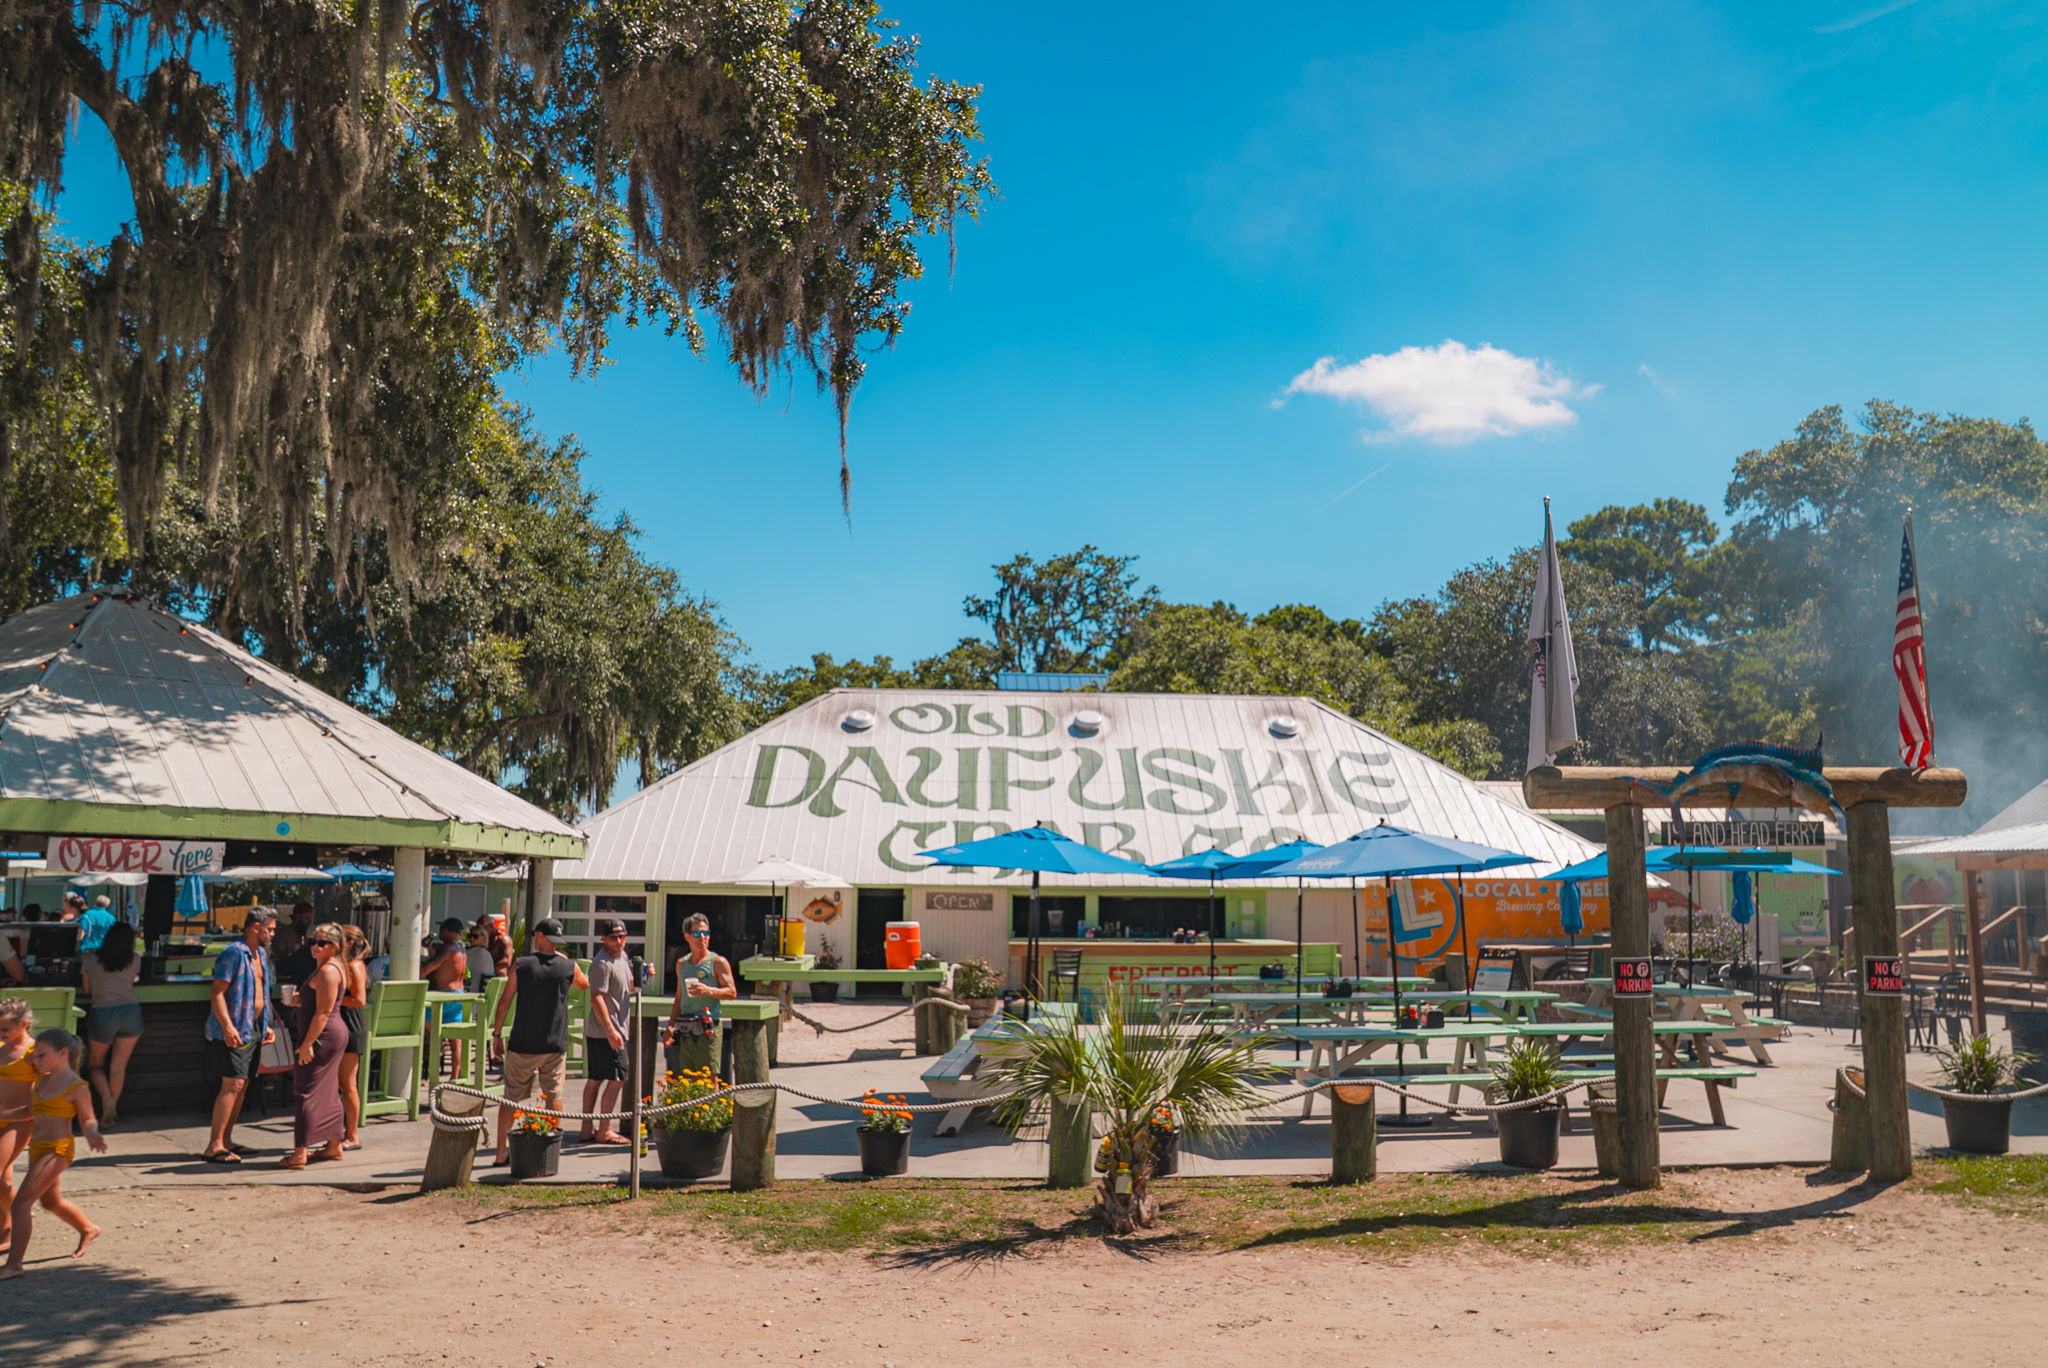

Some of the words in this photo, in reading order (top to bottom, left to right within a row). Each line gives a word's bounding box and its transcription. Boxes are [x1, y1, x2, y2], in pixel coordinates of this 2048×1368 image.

[889, 703, 1056, 738] OLD
[746, 744, 1411, 817] DAUFUSKIE
[1731, 822, 1770, 846] HEAD
[1776, 822, 1820, 846] FERRY
[58, 837, 163, 873] ORDER
[169, 840, 214, 876] here
[878, 819, 1146, 879] CRB
[1462, 882, 1536, 898] LOCAL
[1496, 900, 1544, 915] Brewing
[1620, 963, 1633, 977] NO
[1874, 962, 1888, 976] NO
